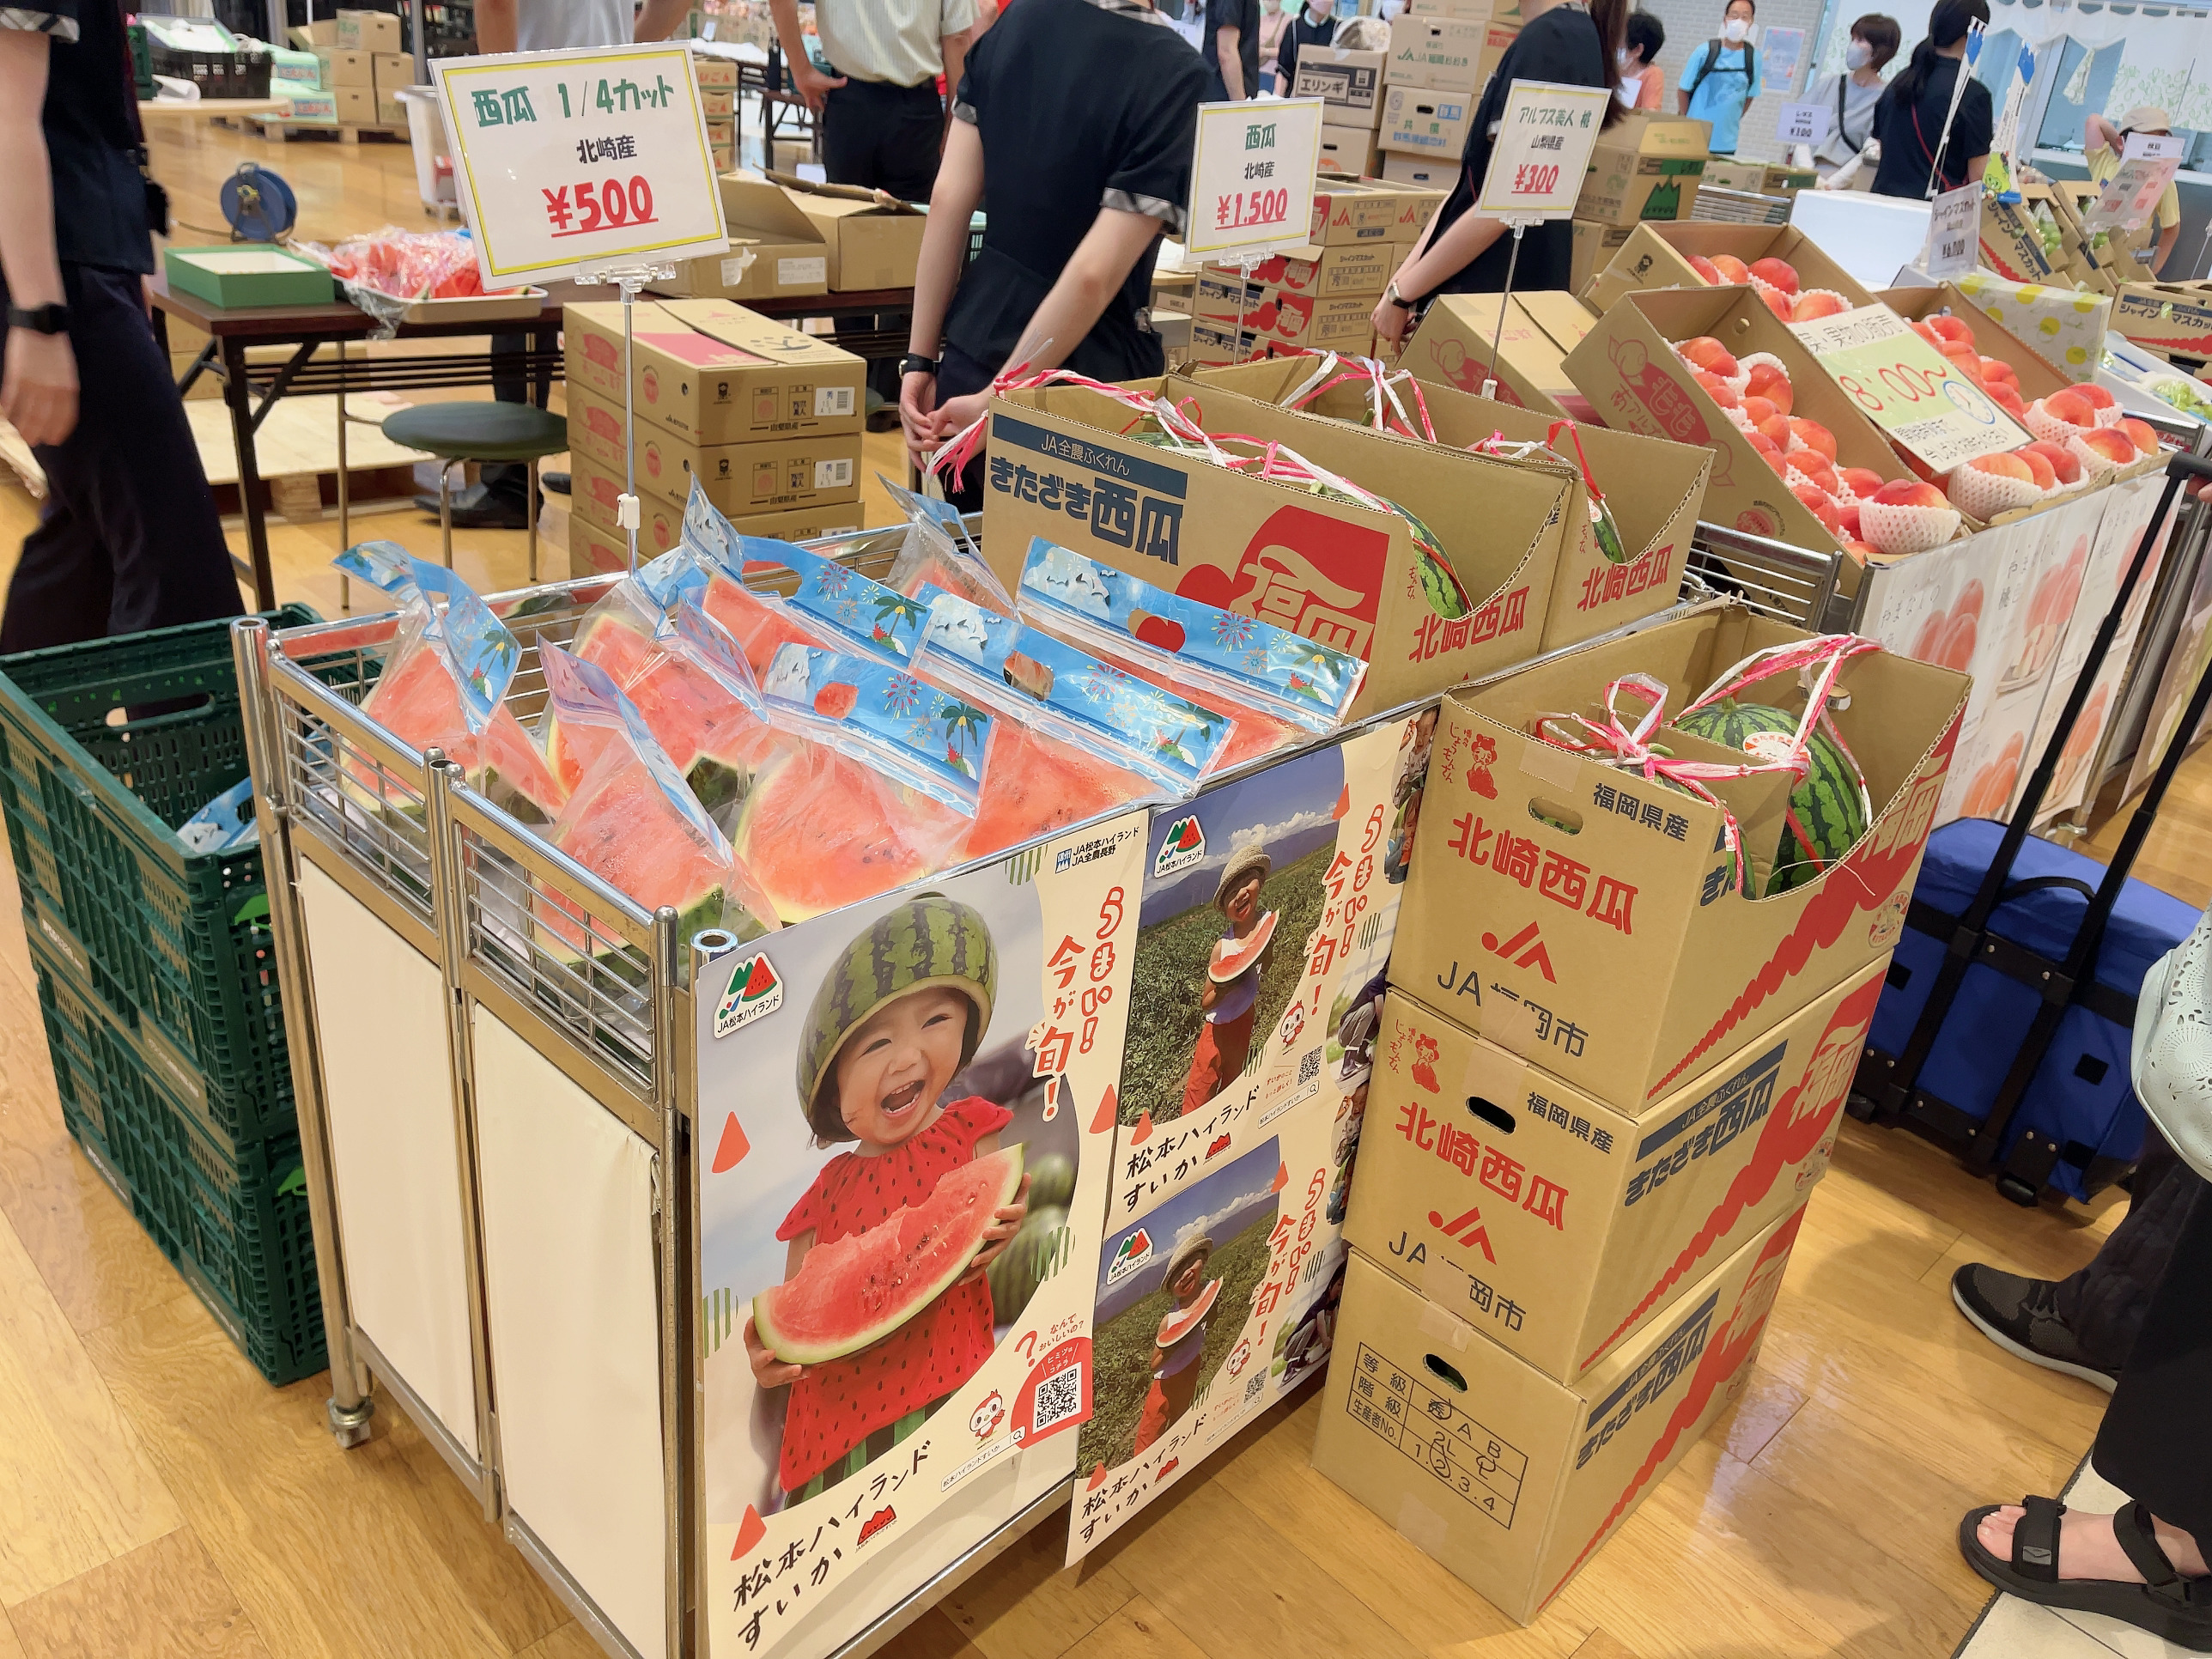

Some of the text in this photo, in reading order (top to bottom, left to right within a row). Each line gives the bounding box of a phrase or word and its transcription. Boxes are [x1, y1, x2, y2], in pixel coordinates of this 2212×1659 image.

[471, 75, 674, 127] 西瓜 1/4カット
[1519, 106, 1575, 128] アルプス美人
[576, 134, 638, 164] 北崎産
[1245, 123, 1277, 150] 西瓜
[1530, 134, 1565, 151] 山梨県産
[1244, 161, 1275, 180] 北崎産
[1514, 164, 1559, 192] ¥300
[541, 174, 654, 231] ¥500
[1040, 432, 1131, 477] JA全農ふくれん
[989, 455, 1183, 567] きたざき西瓜
[1577, 543, 1674, 611] 北崎西瓜
[1408, 586, 1530, 664] 北崎西瓜
[1592, 782, 1689, 842] 福岡県産
[1073, 826, 1140, 856] JA松本ハイランド
[1156, 849, 1203, 874] JA松本ハイランド
[1448, 811, 1638, 935] 北崎西瓜
[717, 994, 780, 1033] JA松本ハイランド
[1126, 1083, 1261, 1181] 松本ハイランド
[1527, 1091, 1614, 1155] 福岡県産
[1624, 1064, 1781, 1207] きたざき西瓜
[1122, 1153, 1199, 1213] すいか
[1395, 1101, 1570, 1231] 北崎西瓜
[1389, 1231, 1527, 1332] JA岡市
[1038, 1320, 1085, 1352] おいしいの?
[1049, 1312, 1078, 1335] なんで
[1352, 1398, 1397, 1441] 生産者No.
[1456, 1422, 1472, 1442] A
[1082, 1412, 1209, 1517] 松本ハイランド
[1486, 1439, 1502, 1459] B
[732, 1439, 932, 1613] 松本ハイランド
[1079, 1482, 1149, 1544] すいか
[738, 1547, 842, 1652] すいか
